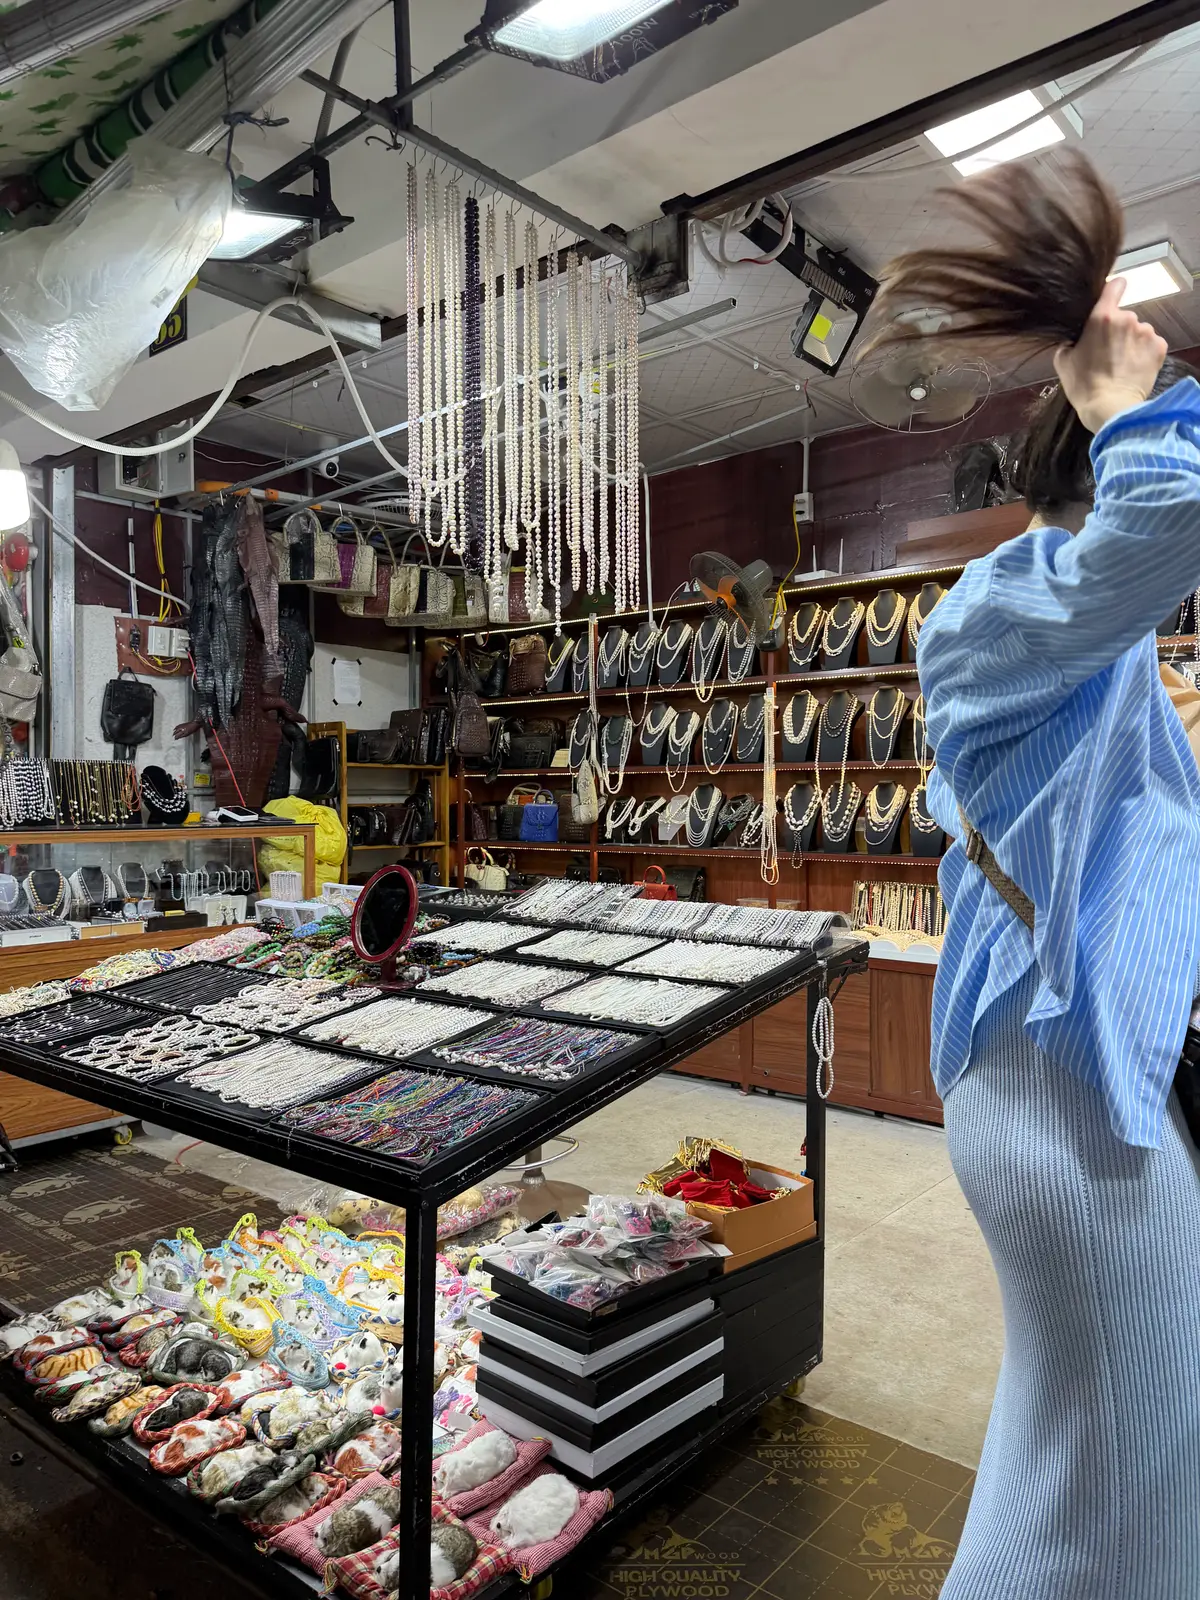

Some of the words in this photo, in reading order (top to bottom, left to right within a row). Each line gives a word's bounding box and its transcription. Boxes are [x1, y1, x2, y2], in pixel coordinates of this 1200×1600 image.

[280, 236, 307, 248] LED
[756, 1449, 797, 1458] HIGH
[801, 1449, 867, 1459] QUALITY
[773, 1460, 860, 1469] PLYWOOD
[694, 1552, 740, 1560] WOOD
[609, 1570, 657, 1583] HIGH
[662, 1569, 741, 1584] QUALITY
[867, 1568, 916, 1581] HIGH
[626, 1585, 730, 1598] PLYWOOD
